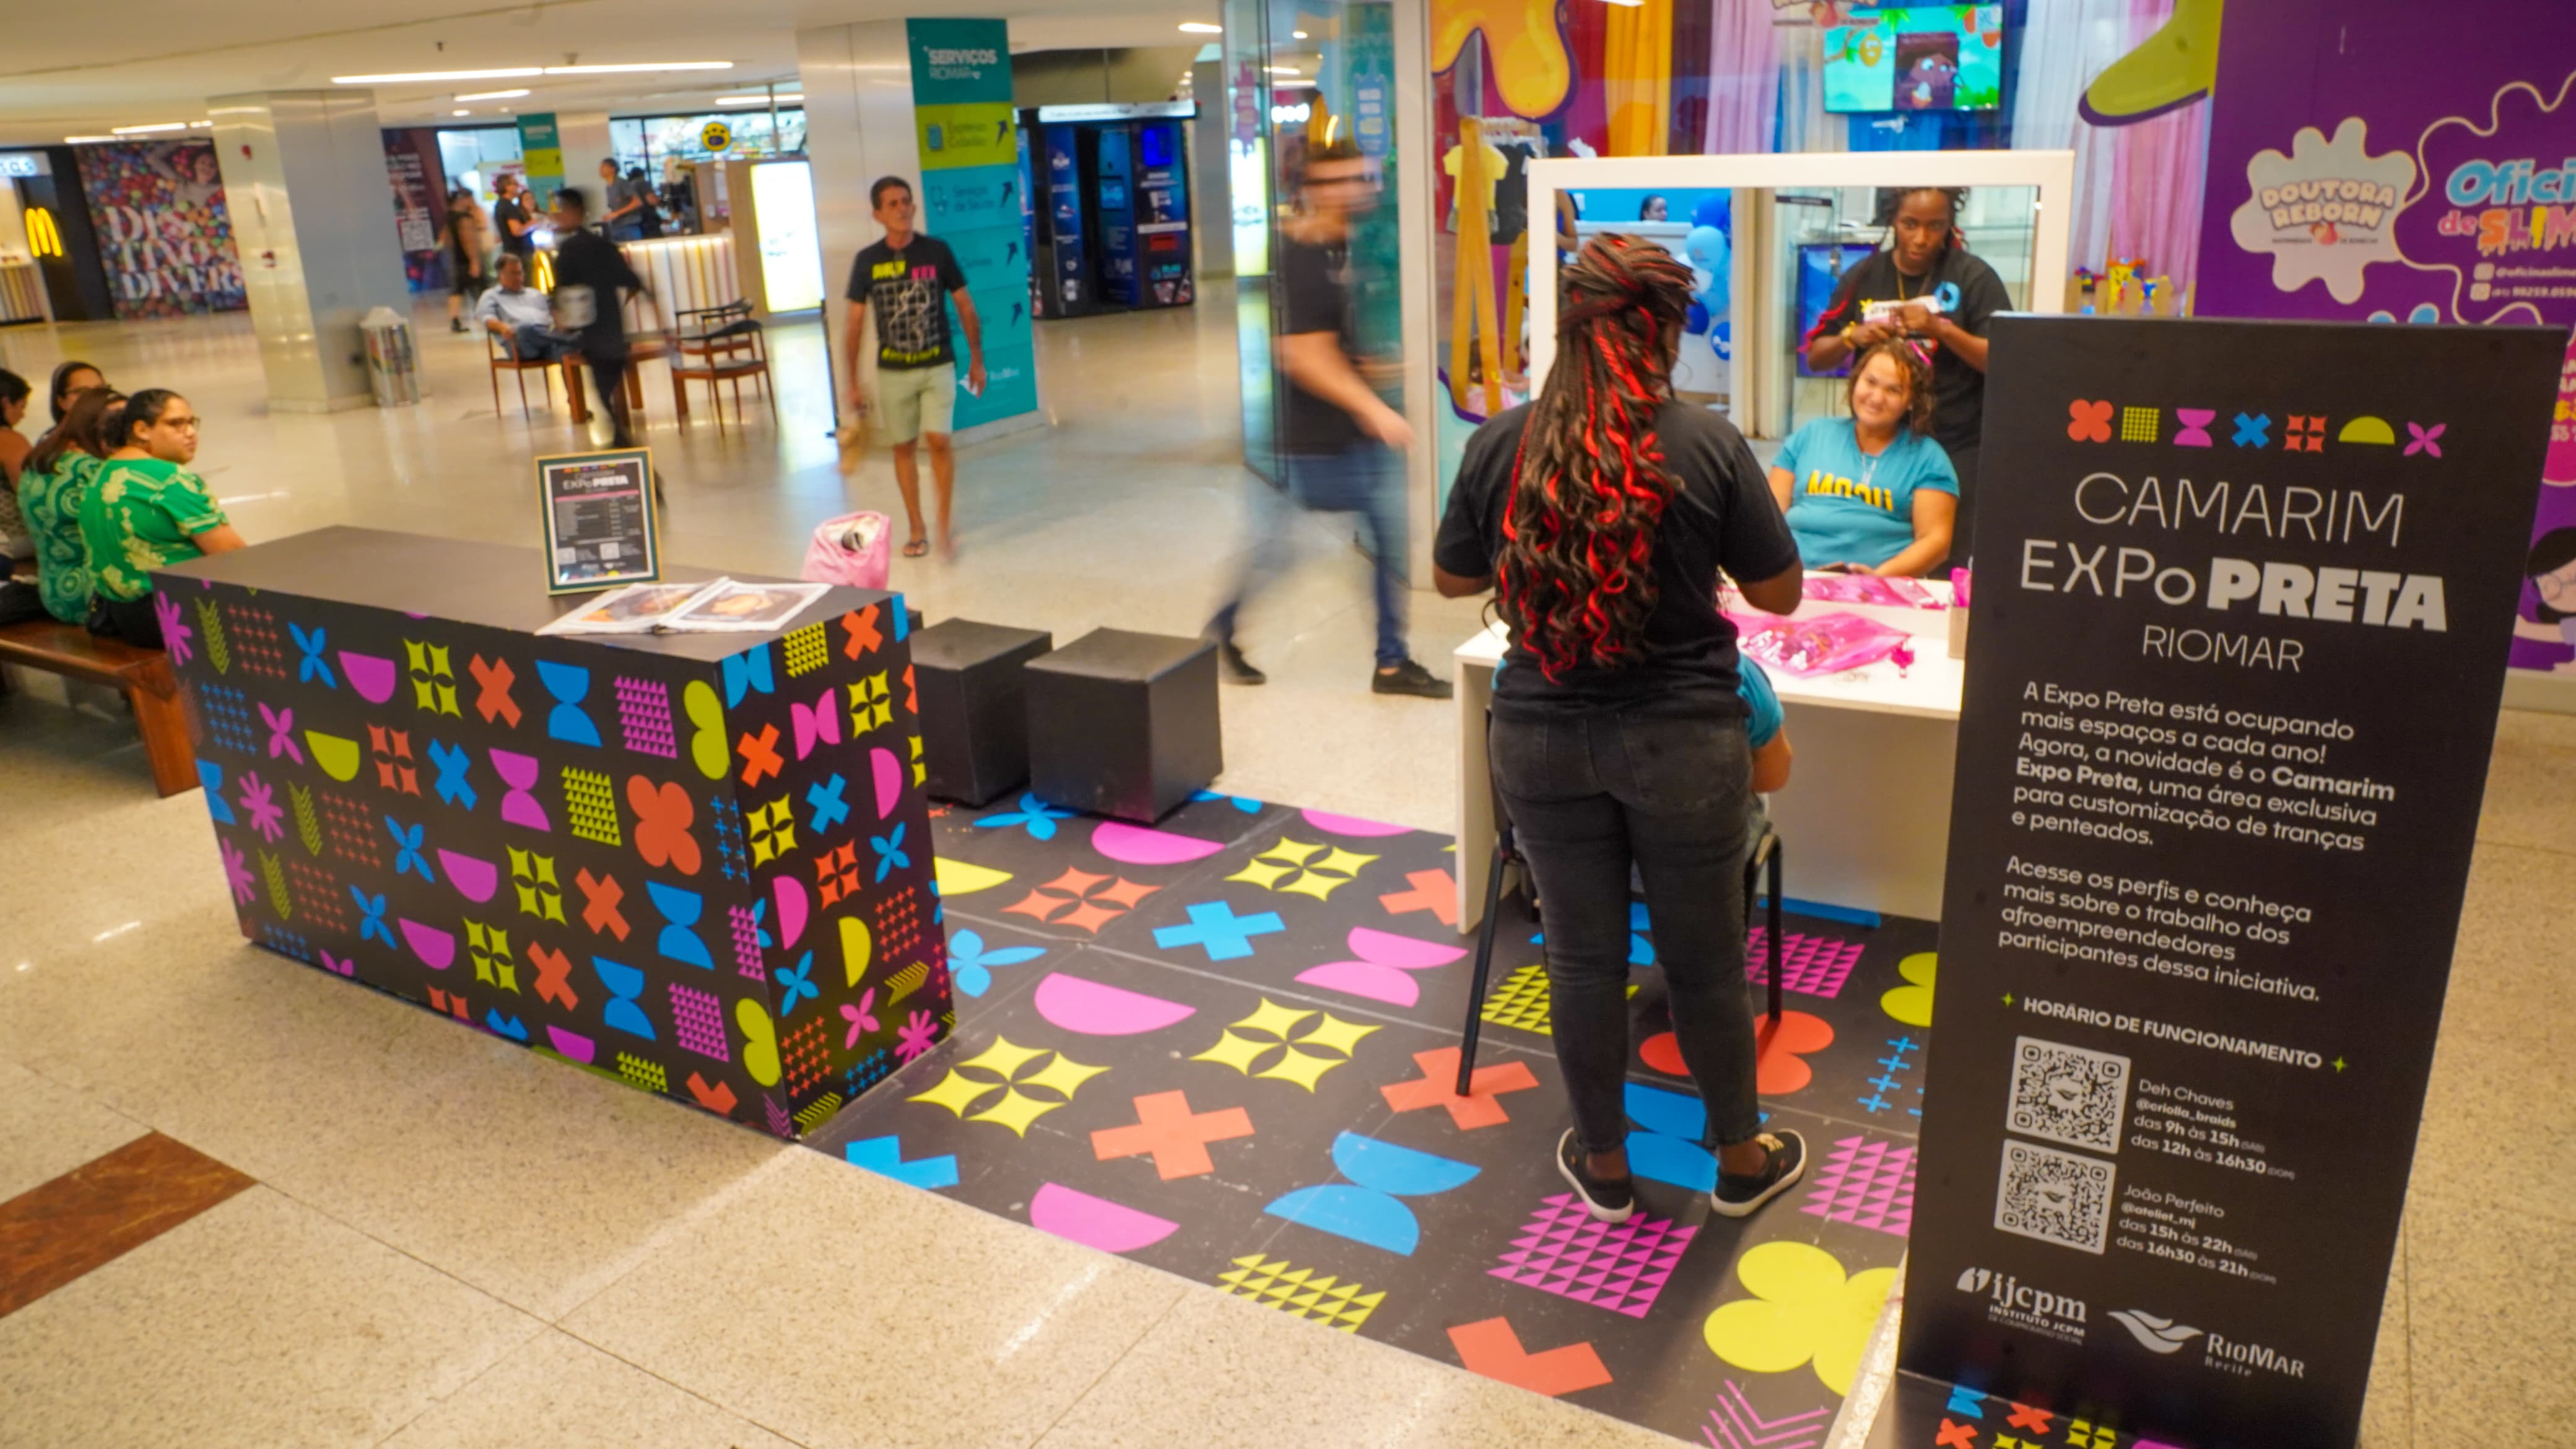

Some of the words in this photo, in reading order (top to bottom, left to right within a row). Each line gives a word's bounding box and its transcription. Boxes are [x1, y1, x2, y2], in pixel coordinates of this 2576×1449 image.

[929, 48, 998, 66] SERVIÇOS
[2260, 177, 2395, 209] DOUTORA
[2271, 201, 2384, 231] REBORN
[2438, 209, 2478, 237] de
[2075, 472, 2404, 547] CAMARIM
[2207, 557, 2447, 632] PRETA
[2143, 624, 2304, 672] RIOMAR
[2024, 681, 2038, 700] A
[2044, 683, 2100, 709] Expo
[2105, 691, 2164, 716] Preta
[2170, 703, 2219, 723] está
[2225, 711, 2354, 740] ocupando
[2021, 711, 2074, 731] mais
[2079, 719, 2176, 744] espaços
[2182, 732, 2197, 747] a
[2203, 735, 2265, 756] cada
[2271, 744, 2326, 764] ano!
[2017, 757, 2072, 783] Expo
[2077, 765, 2142, 794] Preta,
[2149, 780, 2202, 800] uma
[2208, 784, 2261, 809] área
[2267, 797, 2377, 825] exclusiva
[2019, 732, 2089, 761] Agora,
[2095, 747, 2110, 761] a
[2115, 750, 2222, 777] novidade
[2229, 760, 2243, 780] é
[2249, 768, 2266, 783] o
[2272, 766, 2395, 801] Camarim
[2012, 811, 2026, 825] e
[2030, 814, 2152, 845] penteados.
[2014, 786, 2064, 806] para
[2069, 794, 2230, 830] customização
[2236, 816, 2267, 836] de
[2273, 821, 2364, 851] tranças
[2004, 884, 2055, 904] mais
[2060, 893, 2120, 915] sobre
[2125, 905, 2141, 919] o
[2146, 905, 2240, 936] trabalho
[2246, 921, 2289, 944] dos
[2006, 856, 2082, 884] Acesse
[2087, 874, 2113, 889] os
[2118, 878, 2179, 902] perfis
[2185, 889, 2199, 903] e
[2205, 892, 2311, 923] conheça
[2001, 906, 2235, 960] afroempreendedores
[1999, 931, 2138, 968] participantes
[2143, 954, 2209, 981] dessa
[2214, 965, 2319, 1001] iniciativa.
[2024, 997, 2111, 1027] HORÁRIO
[2115, 1015, 2141, 1033] DE
[2144, 1020, 2321, 1068] FUNCIONAMENTO
[2139, 1079, 2170, 1097] Deh
[2174, 1087, 2234, 1110] Chaves
[2131, 1134, 2159, 1150] das
[2162, 1139, 2191, 1157] 12h
[2216, 1152, 2266, 1174] 16h30
[2134, 1115, 2162, 1130] das
[2165, 1120, 2185, 1136] 9h
[2209, 1130, 2239, 1147] 15h
[2165, 1193, 2224, 1217] Perfeito
[2117, 1236, 2144, 1251] das
[2147, 1242, 2195, 1263] 16h30
[2219, 1260, 2248, 1277] 21h
[2119, 1218, 2146, 1233] das
[2150, 1224, 2178, 1240] 15h
[2202, 1236, 2232, 1253] 22h
[1989, 1304, 2050, 1328] INSTITUTO
[2053, 1321, 2086, 1338] JCPM
[1991, 1273, 2087, 1323] ijcpm
